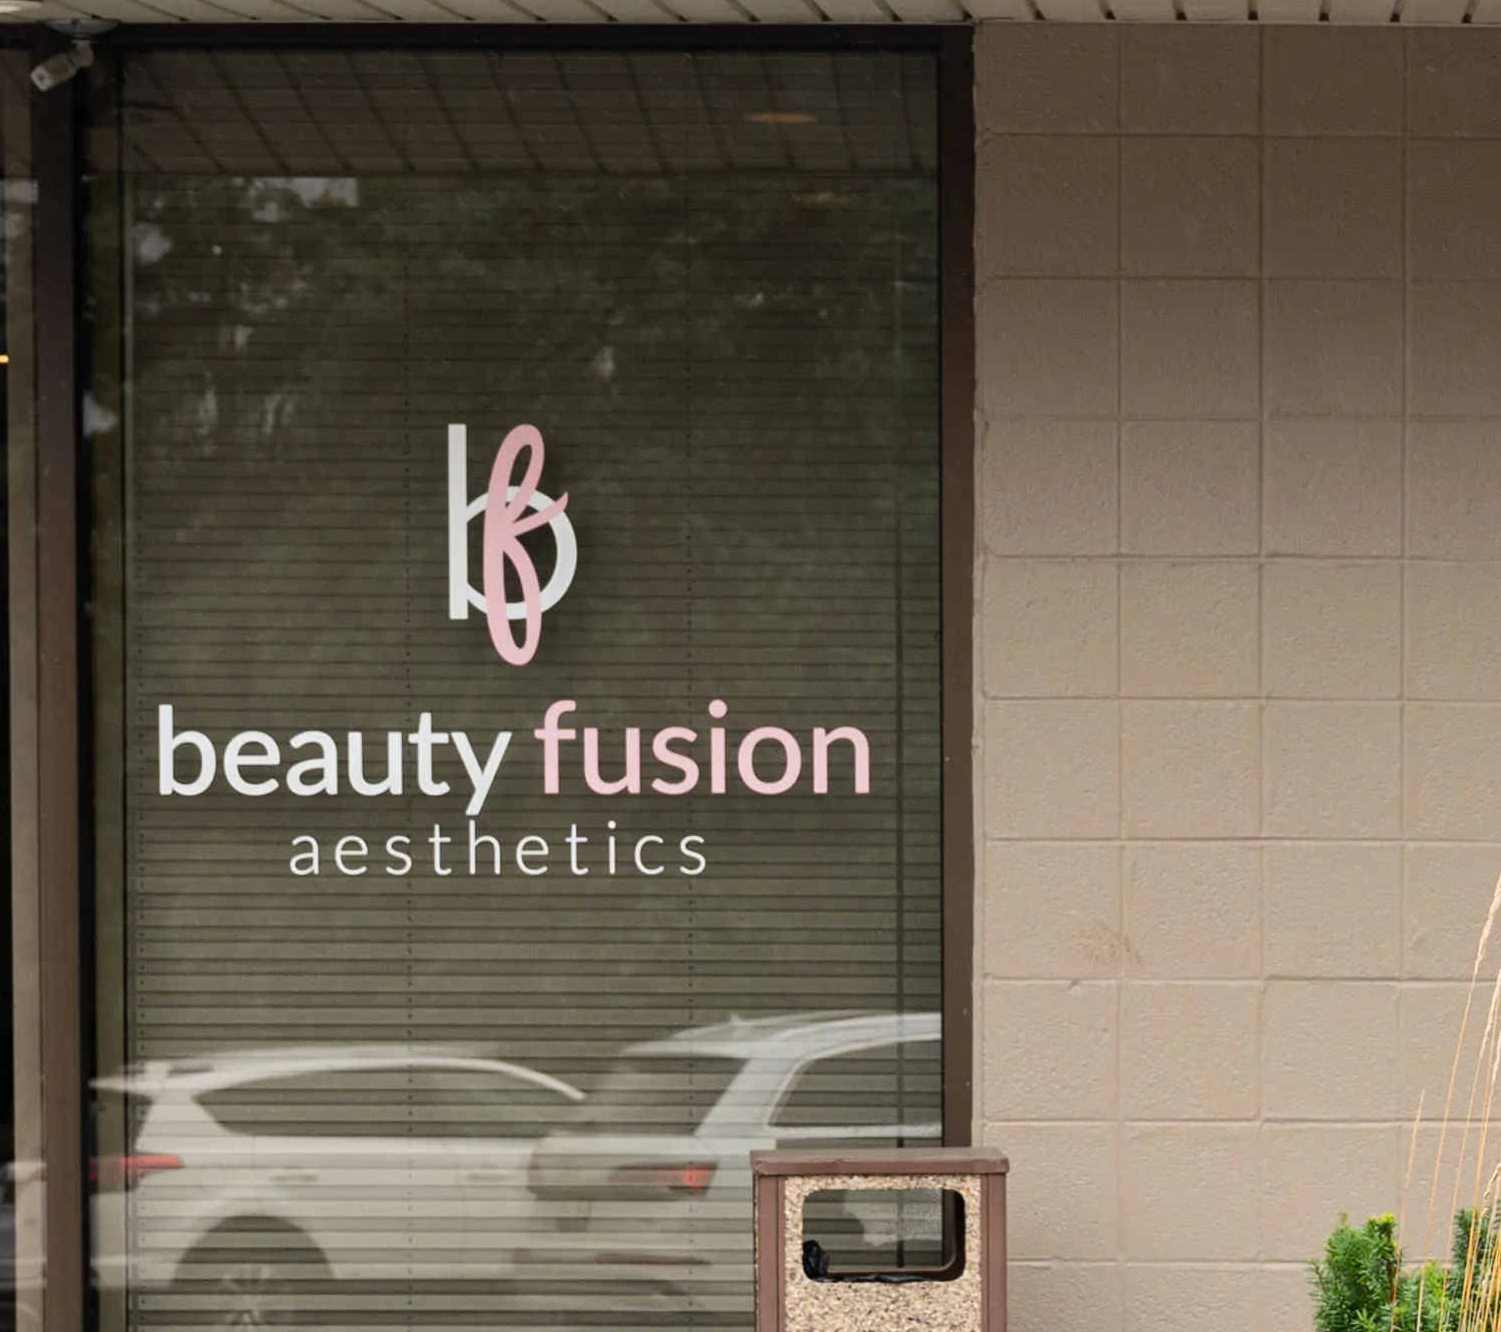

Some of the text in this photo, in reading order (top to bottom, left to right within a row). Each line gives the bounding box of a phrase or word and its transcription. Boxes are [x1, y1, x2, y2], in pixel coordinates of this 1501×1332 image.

[158, 699, 870, 815] beauty fusion
[289, 820, 707, 875] aesthetics
